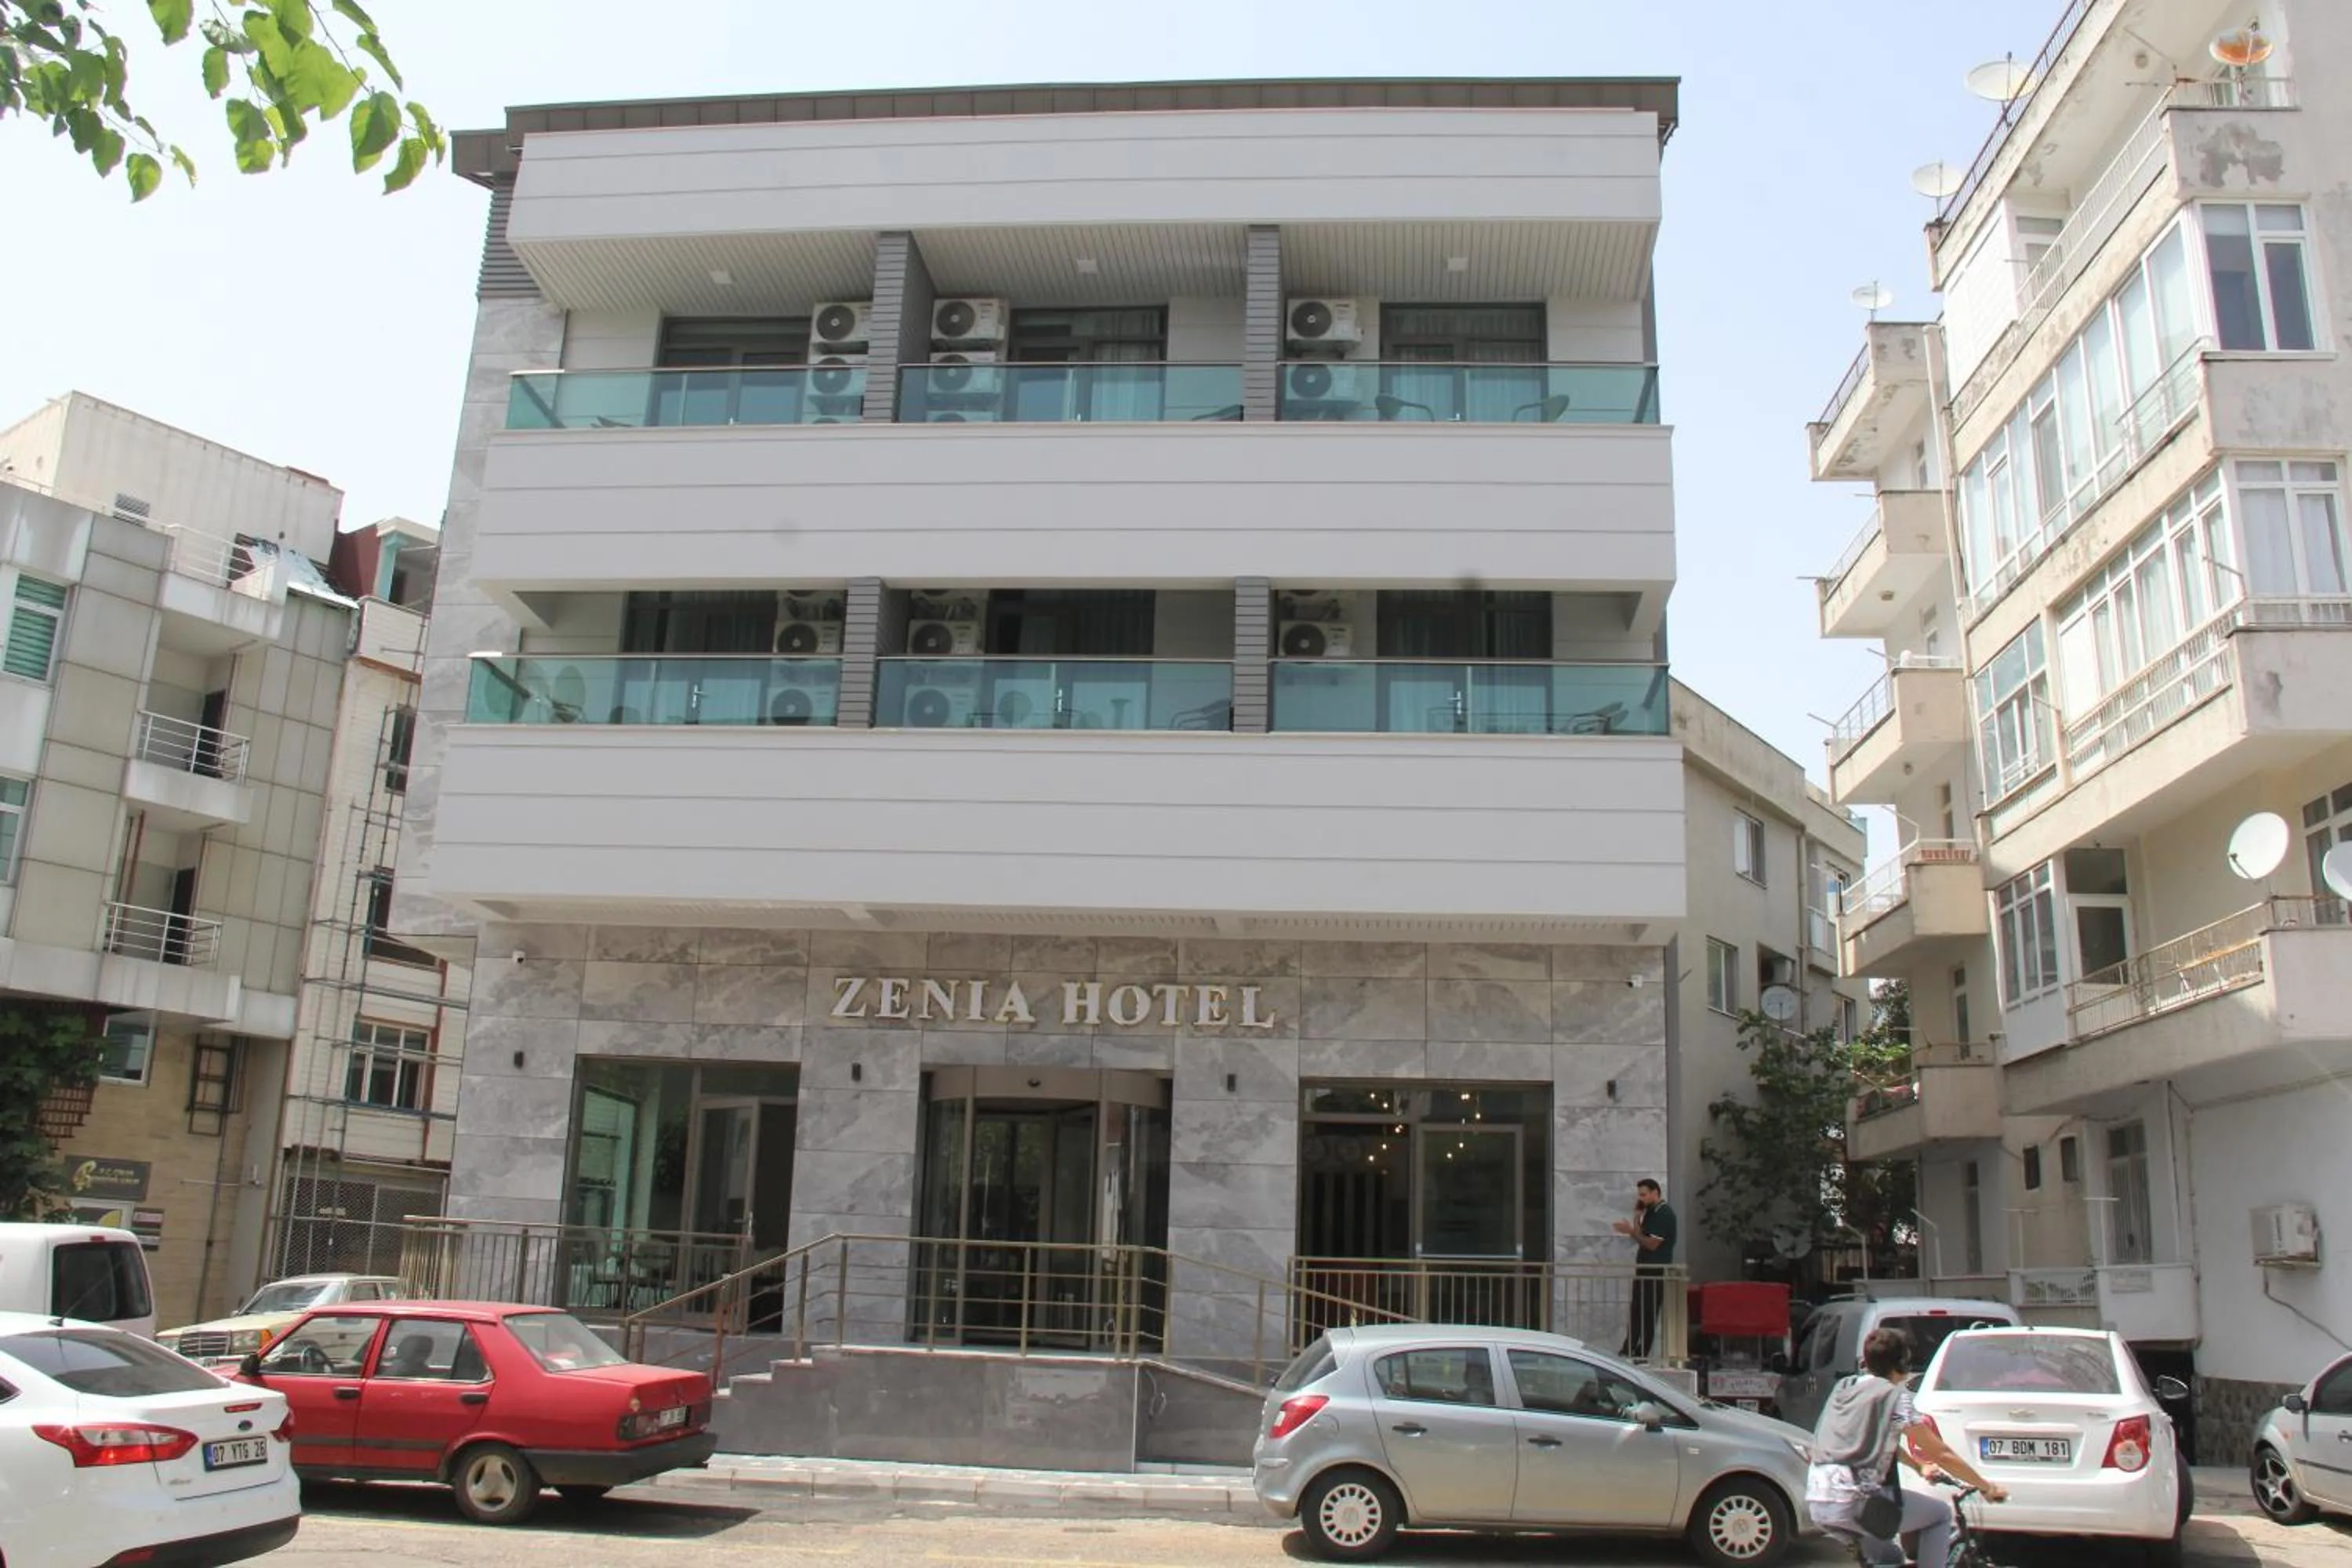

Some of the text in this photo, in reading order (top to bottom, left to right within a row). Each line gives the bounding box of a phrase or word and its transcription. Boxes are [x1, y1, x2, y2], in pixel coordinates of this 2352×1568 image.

[830, 977, 1276, 1028] ZENIA HOTEL
[212, 1445, 224, 1463] 07
[1989, 1440, 2066, 1456] 07 BDM 181
